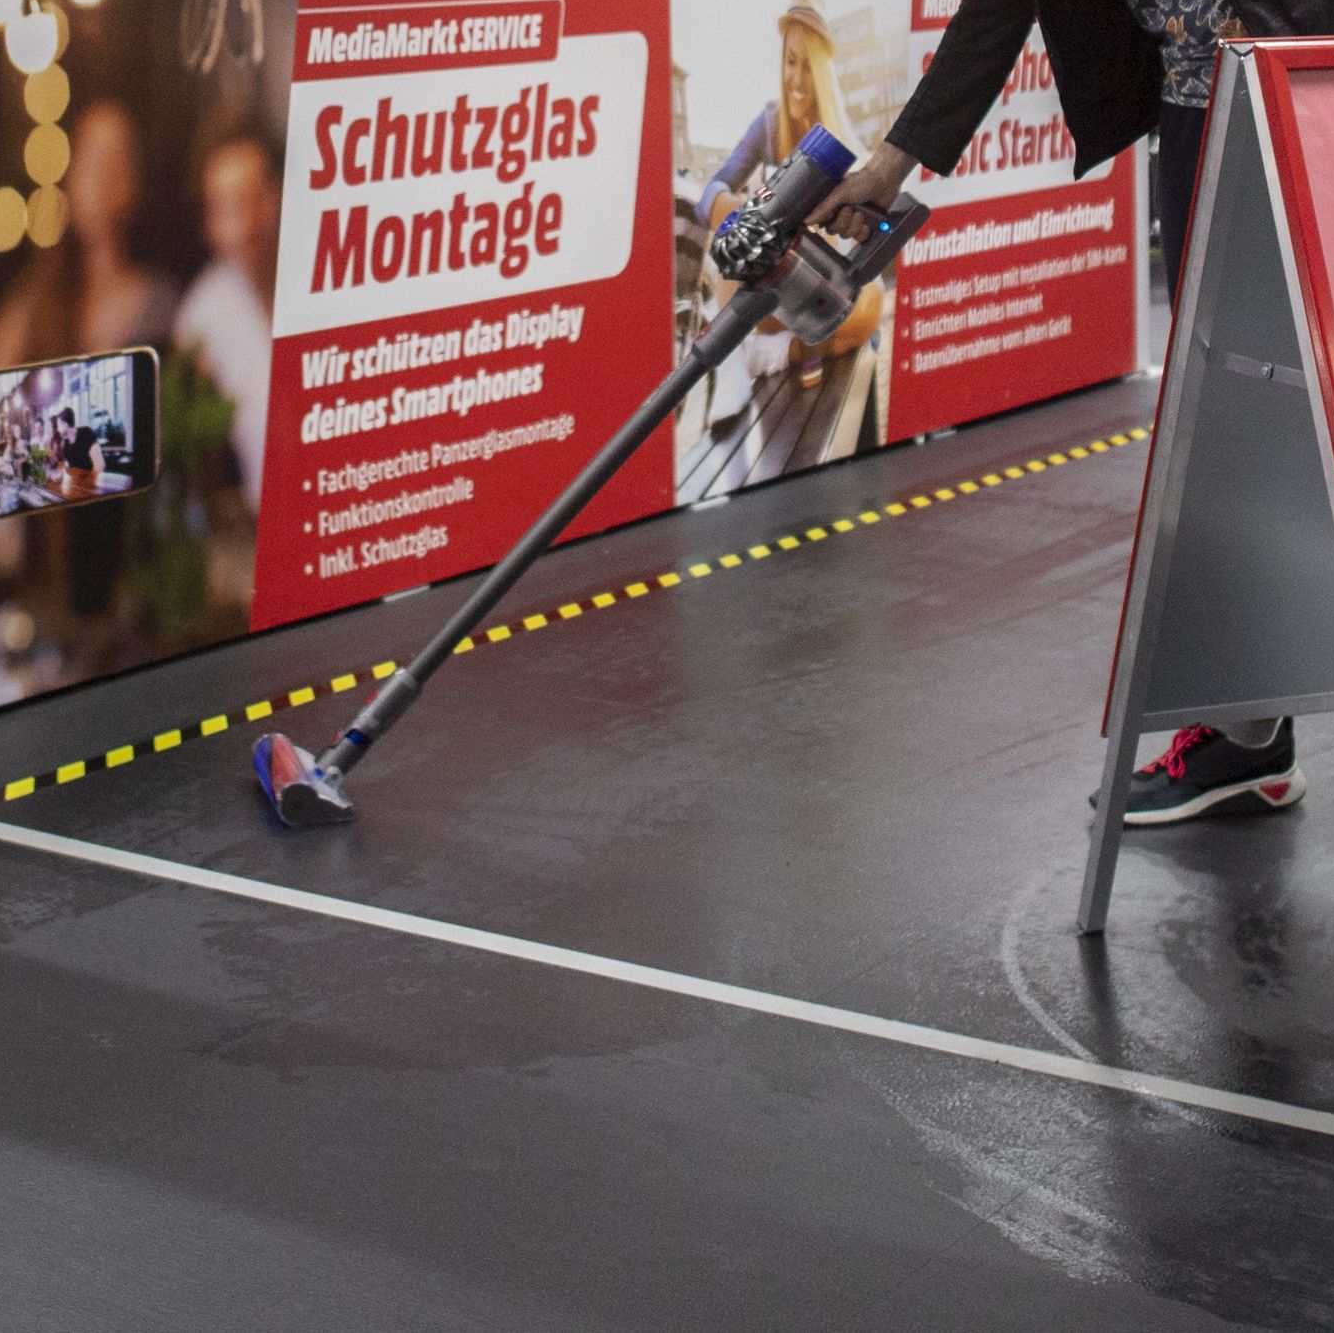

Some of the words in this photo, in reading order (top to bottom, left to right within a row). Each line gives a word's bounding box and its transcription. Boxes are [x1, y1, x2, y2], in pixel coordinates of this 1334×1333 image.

[307, 18, 458, 65] MediaMarkt
[460, 12, 543, 53] SERVICE
[309, 82, 601, 192] Schutzglas
[309, 180, 563, 295] Montage
[901, 218, 1013, 268] Vorinstallation
[1013, 212, 1040, 241] und
[1040, 198, 1115, 239] Einrichtung
[301, 348, 351, 390] Wir
[352, 327, 463, 380] schützen
[464, 319, 504, 359] das
[505, 303, 585, 350] Display
[300, 393, 388, 445] deines
[390, 363, 544, 426] Smartphones
[317, 442, 429, 496] Fachgerechte
[431, 411, 576, 468] Panzerglasmontage
[318, 476, 474, 538] Funktionskontrolle
[319, 545, 356, 580] Inkl.
[361, 524, 448, 570] Schutzglas
